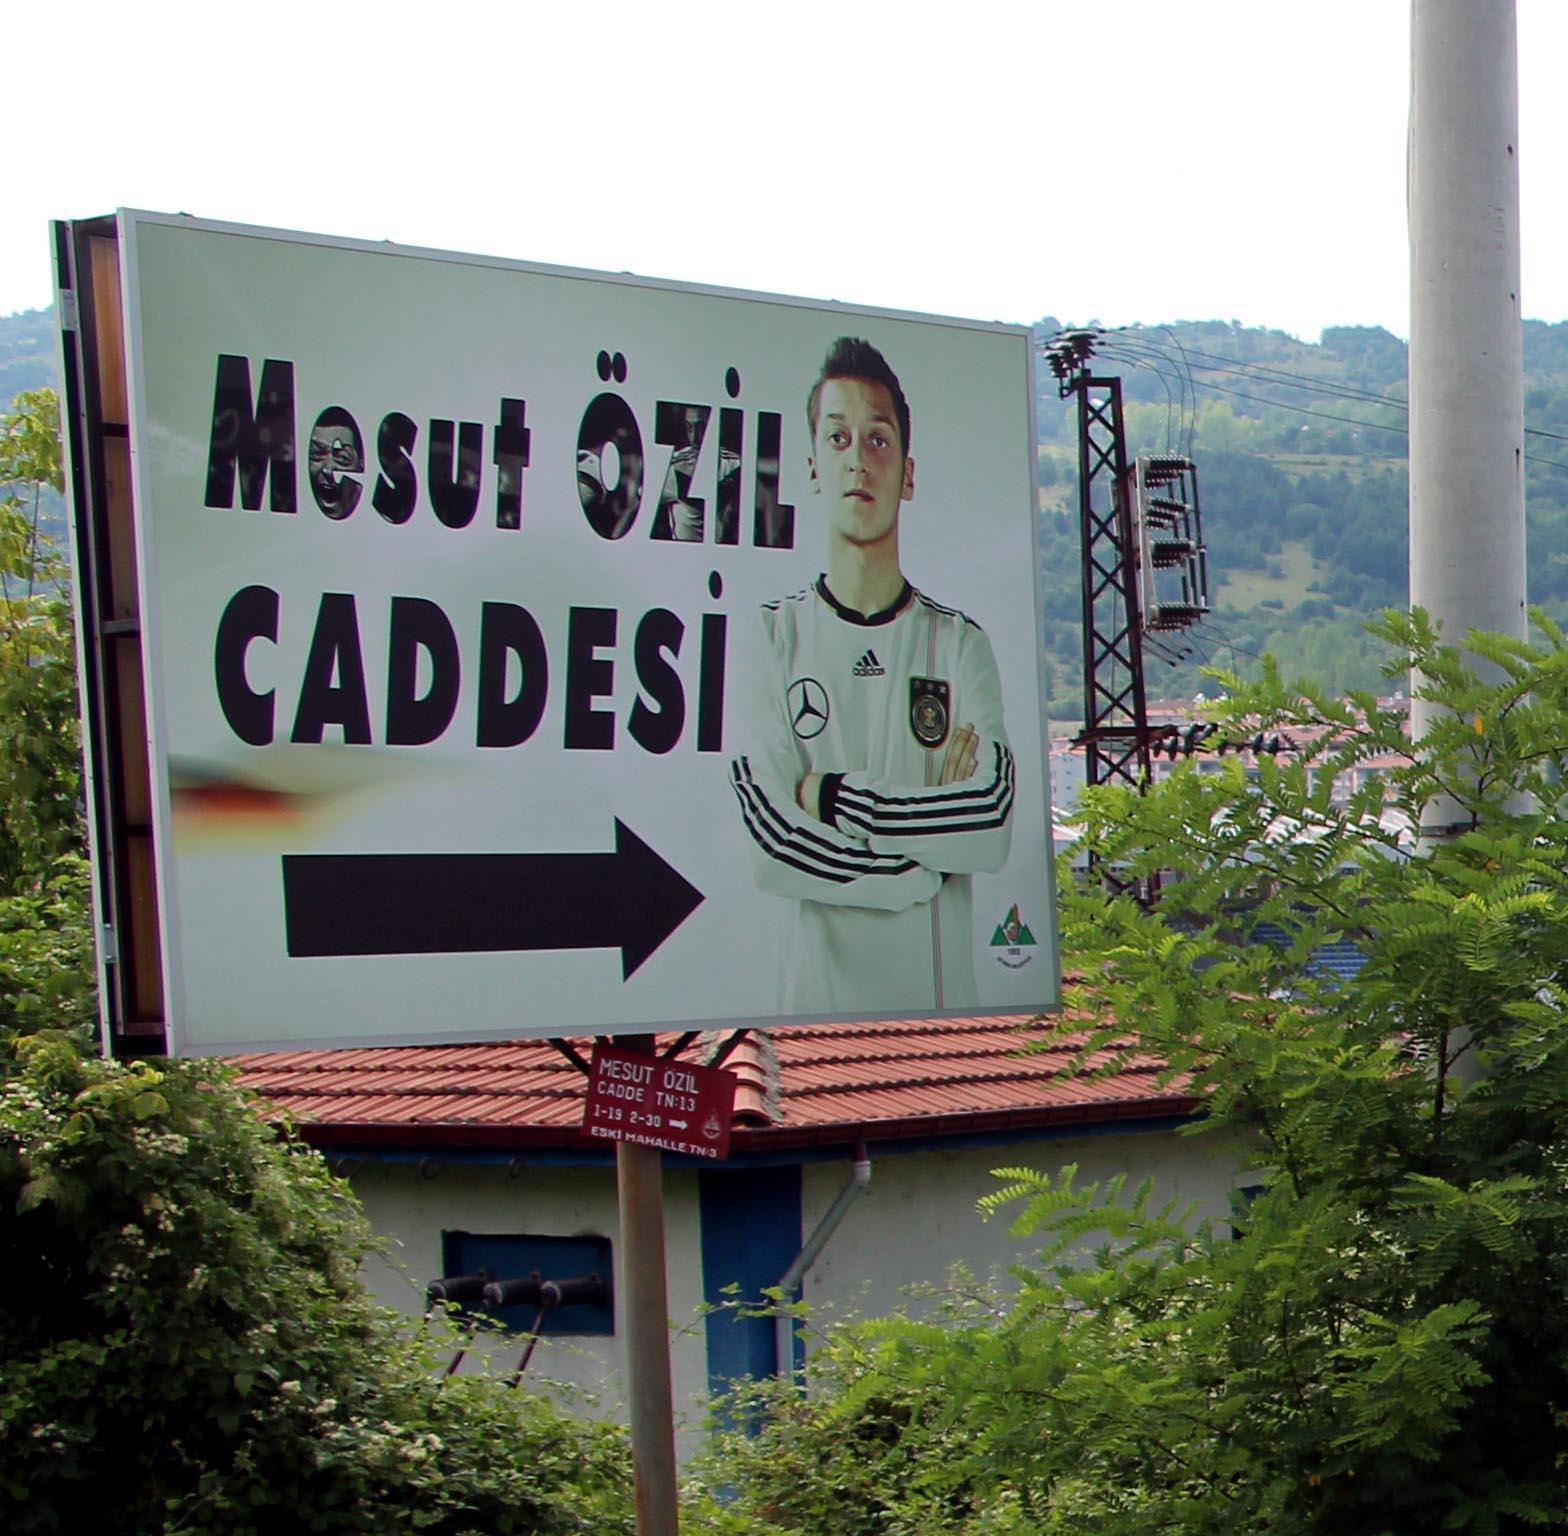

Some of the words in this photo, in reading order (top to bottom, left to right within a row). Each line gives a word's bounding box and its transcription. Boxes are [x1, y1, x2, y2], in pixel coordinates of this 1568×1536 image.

[204, 353, 531, 530] Mesut
[576, 349, 795, 551] ÖZİL
[214, 569, 728, 755] CADDESİ
[599, 1058, 655, 1085] MESUT
[663, 1067, 699, 1094] ÖZİL
[597, 1080, 645, 1102] CADDE
[656, 1091, 696, 1112] TN:13
[593, 1104, 623, 1121] 1-19
[629, 1111, 662, 1127] 2-30
[591, 1126, 621, 1139] ESKİ
[625, 1132, 687, 1152] MAHALLE
